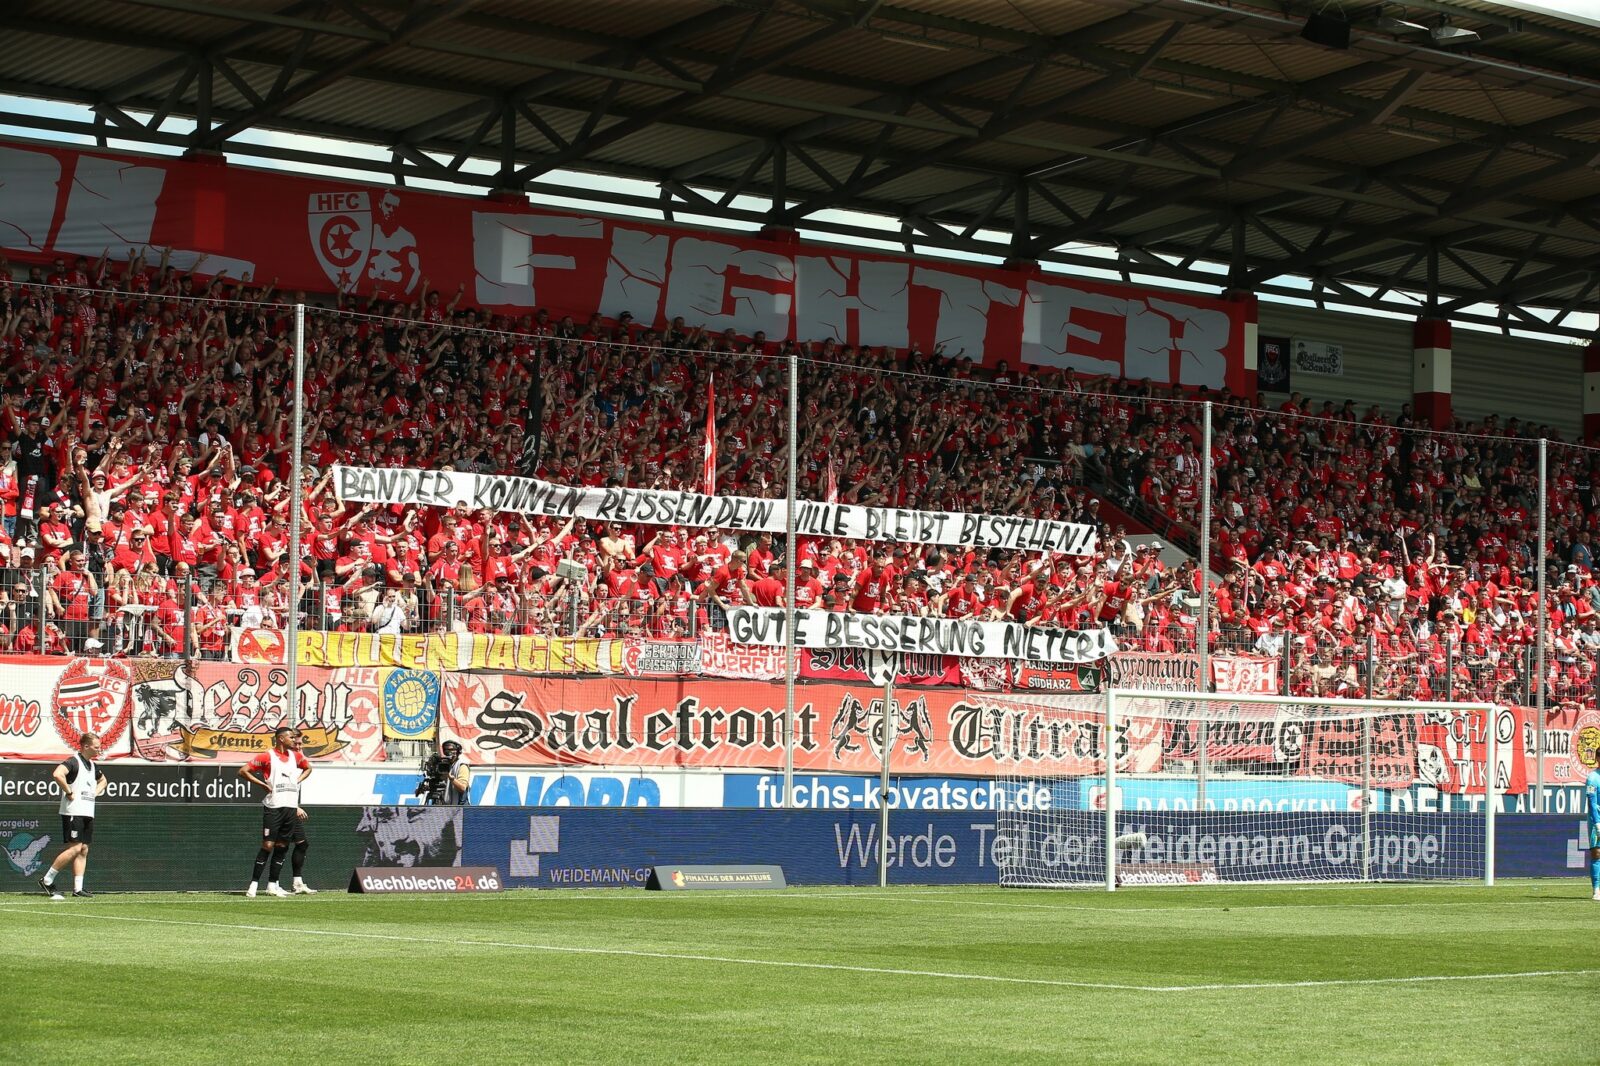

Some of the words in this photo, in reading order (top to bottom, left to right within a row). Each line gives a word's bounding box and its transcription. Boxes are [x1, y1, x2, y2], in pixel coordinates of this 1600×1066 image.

[318, 193, 359, 210] HFC
[472, 211, 1230, 390] FIGHTER
[340, 466, 453, 503] BÄNDER
[714, 498, 774, 527] DEIN
[865, 507, 949, 542] BLEIBT
[958, 514, 1095, 555] BESTEHEN!
[733, 609, 809, 645] GUTE
[825, 612, 985, 656] BESSERUNG
[1004, 624, 1105, 661] NIETER!
[1028, 674, 1071, 690] SÜDHARZ
[476, 690, 819, 751] Saalefront
[1451, 710, 1516, 744] CHO
[149, 778, 199, 798] sucht
[206, 778, 251, 798] dich!
[756, 776, 1052, 810] fuchs-kovatsch.de
[1516, 788, 1589, 813] AUTOM
[834, 822, 956, 868] Werde
[970, 823, 1029, 868] Teil
